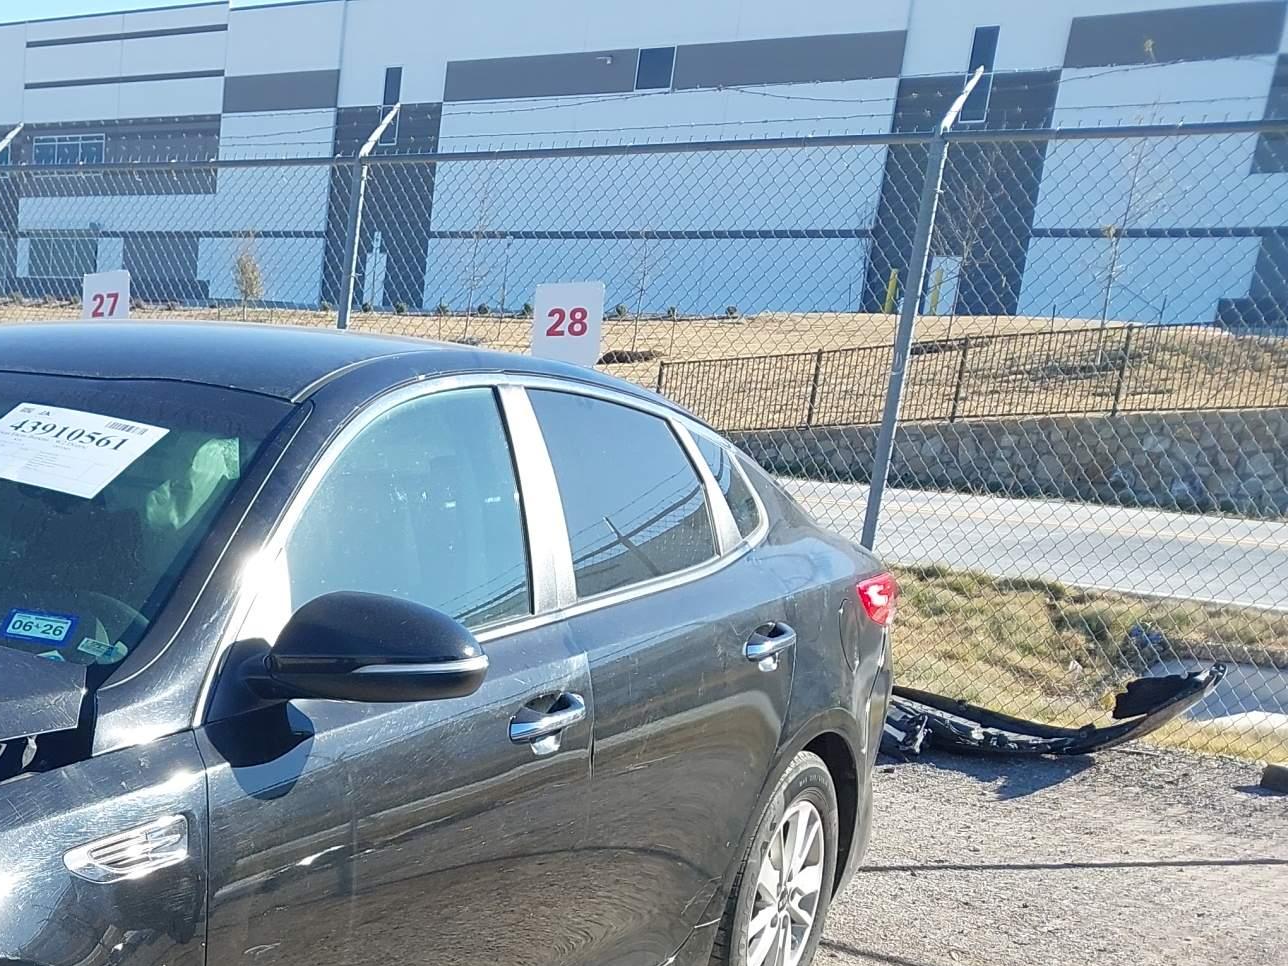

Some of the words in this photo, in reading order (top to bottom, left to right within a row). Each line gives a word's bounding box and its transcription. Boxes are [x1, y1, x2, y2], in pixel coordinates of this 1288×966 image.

[91, 292, 119, 318] 27
[545, 307, 588, 337] 28
[10, 419, 130, 451] 43910561
[11, 619, 34, 632] 06
[40, 623, 65, 637] 26
